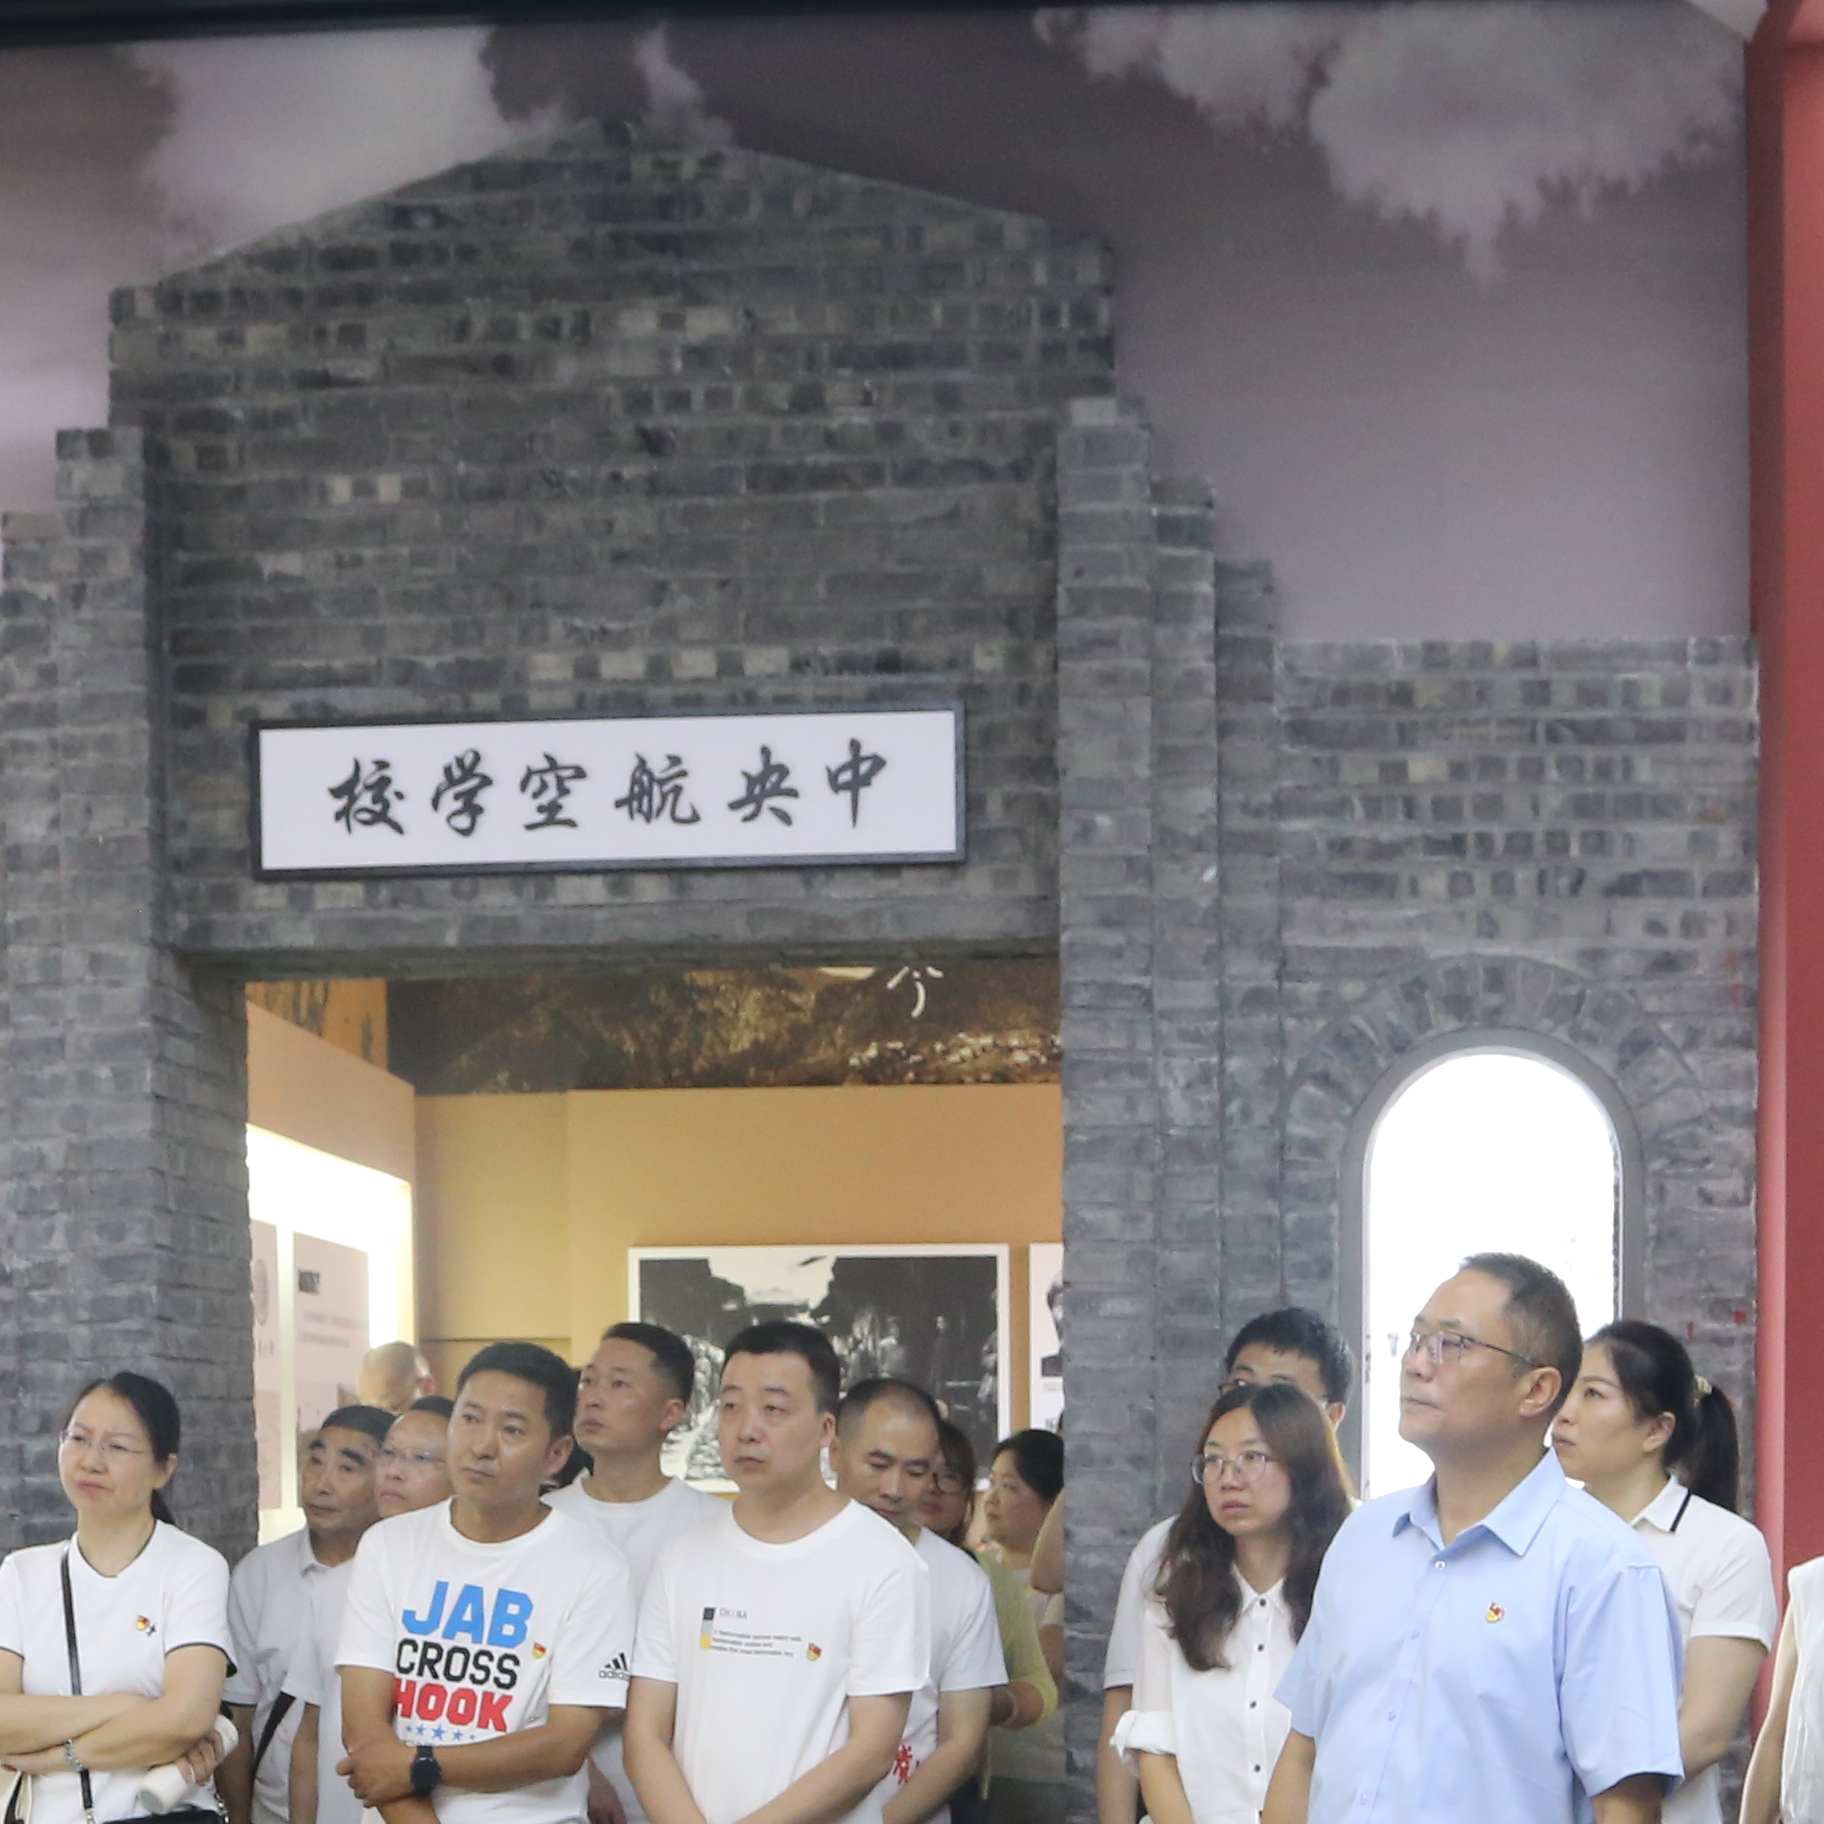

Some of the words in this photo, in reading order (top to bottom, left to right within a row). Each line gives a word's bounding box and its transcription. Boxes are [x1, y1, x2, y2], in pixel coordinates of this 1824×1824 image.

[327, 738, 887, 837] 中央航空学校
[401, 1579, 534, 1649] JAB
[395, 1637, 521, 1691] CROSS
[394, 1676, 513, 1733] HOOK
